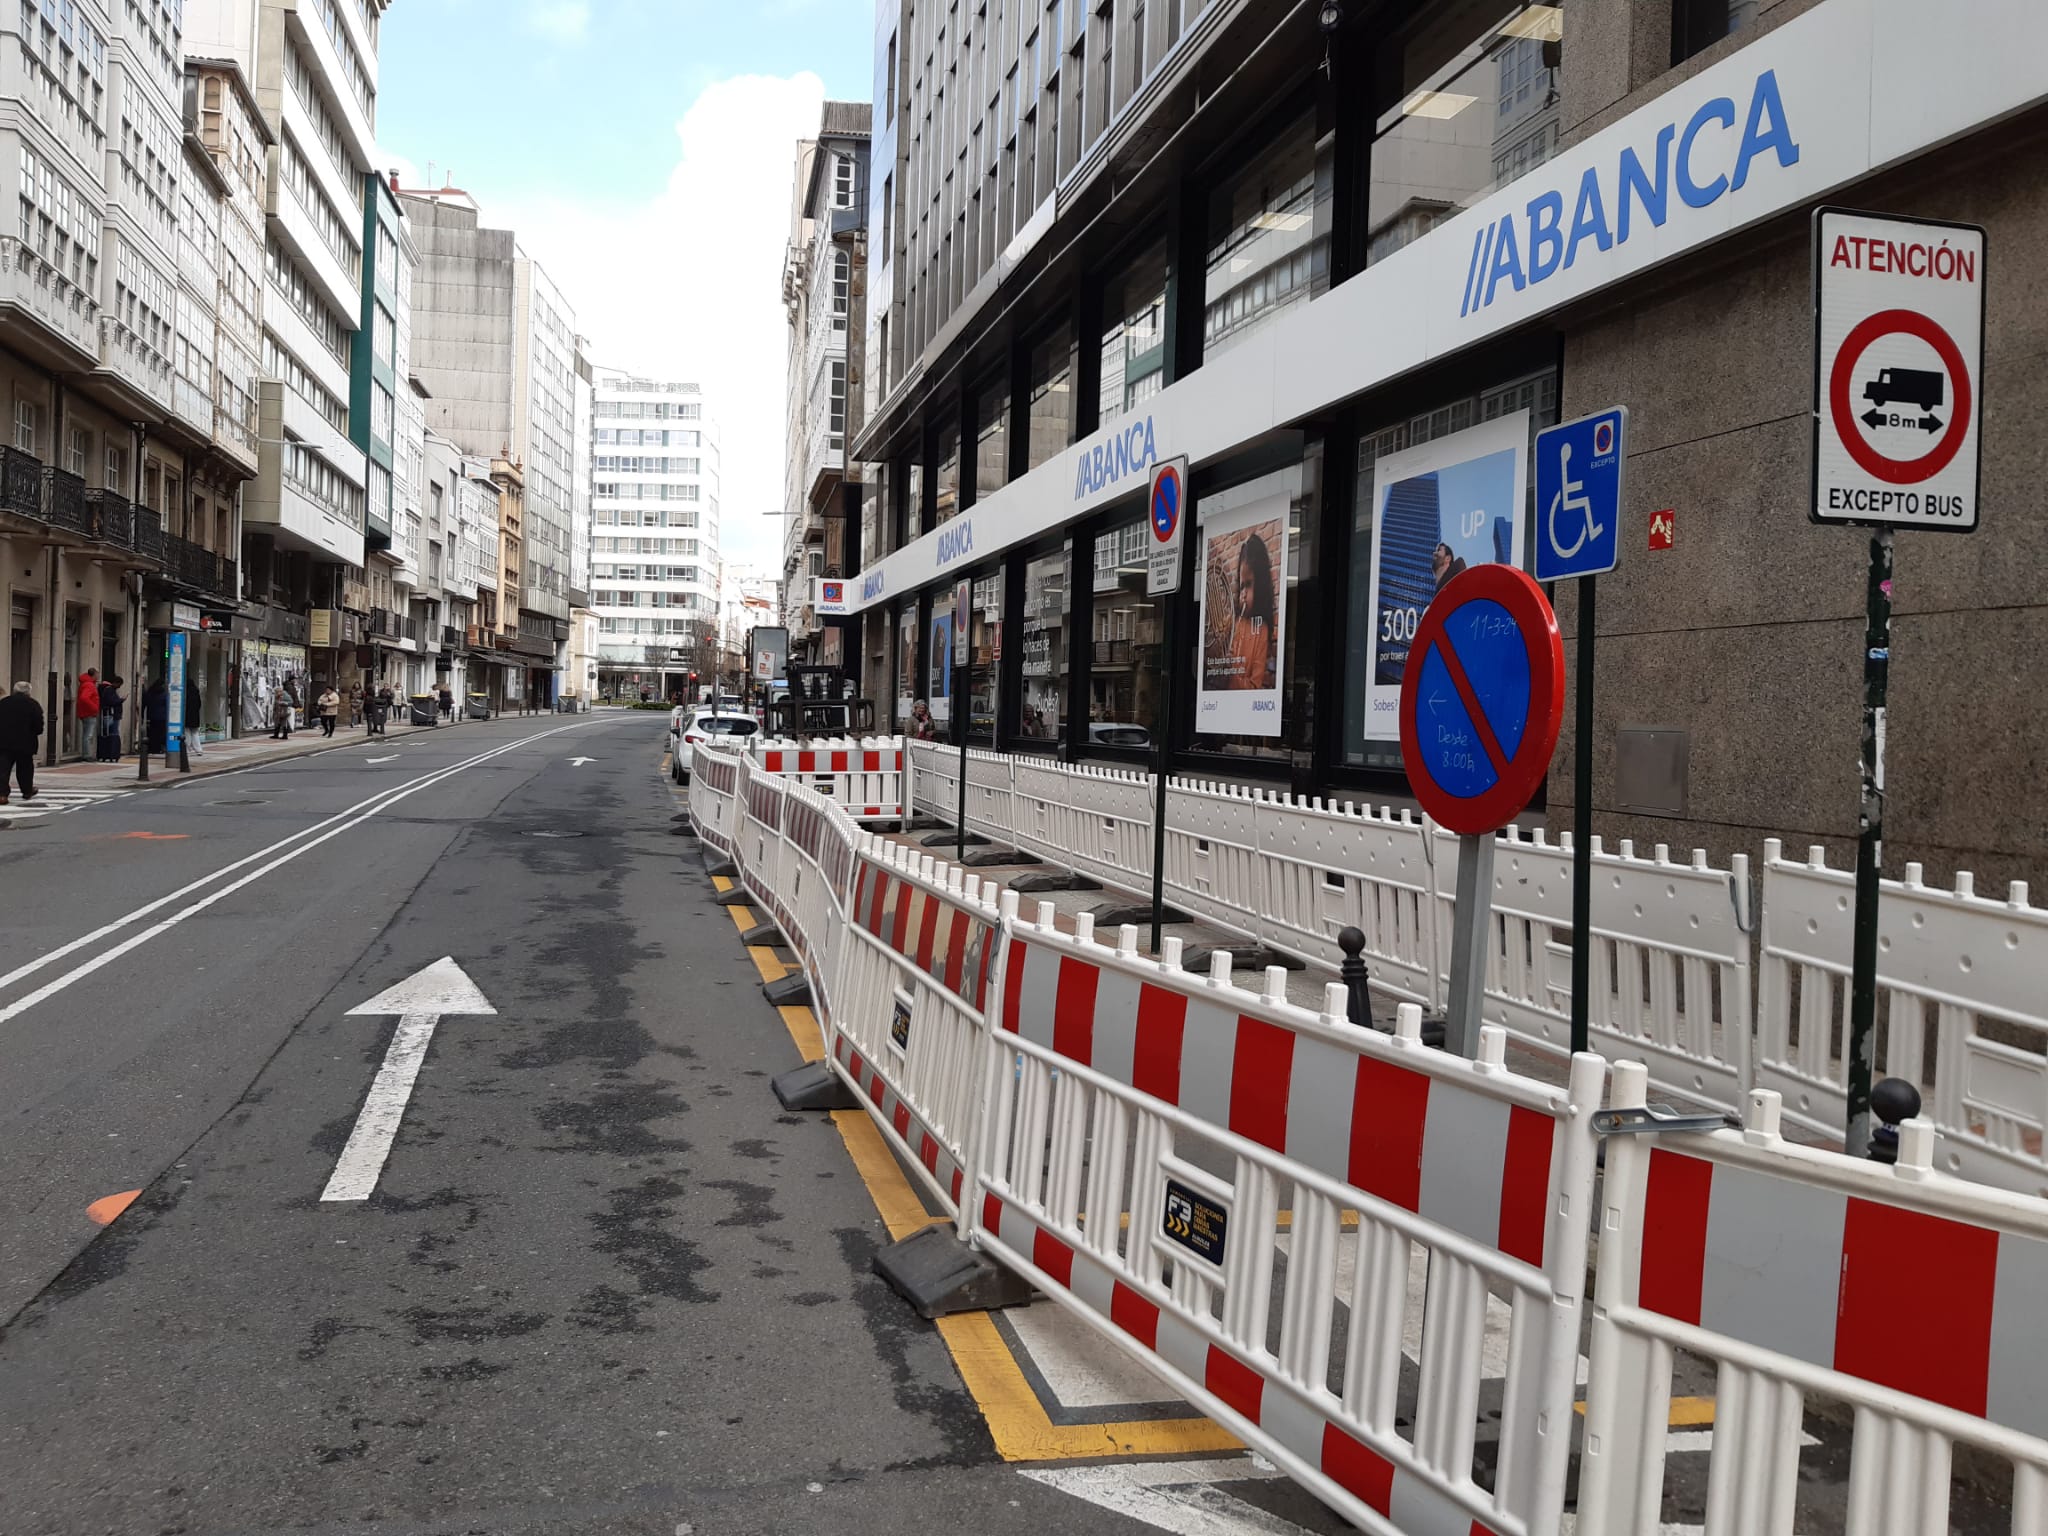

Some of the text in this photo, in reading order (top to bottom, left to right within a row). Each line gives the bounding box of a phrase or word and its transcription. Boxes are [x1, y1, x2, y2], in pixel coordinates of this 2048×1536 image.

[1830, 234, 1975, 282] ATENCIÓN
[1590, 456, 1616, 470] EXCEPTO
[1829, 488, 1964, 517] EXCEPTO BUS
[1461, 508, 1486, 538] UP
[1250, 615, 1263, 635] UP
[1438, 724, 1469, 746] Desde
